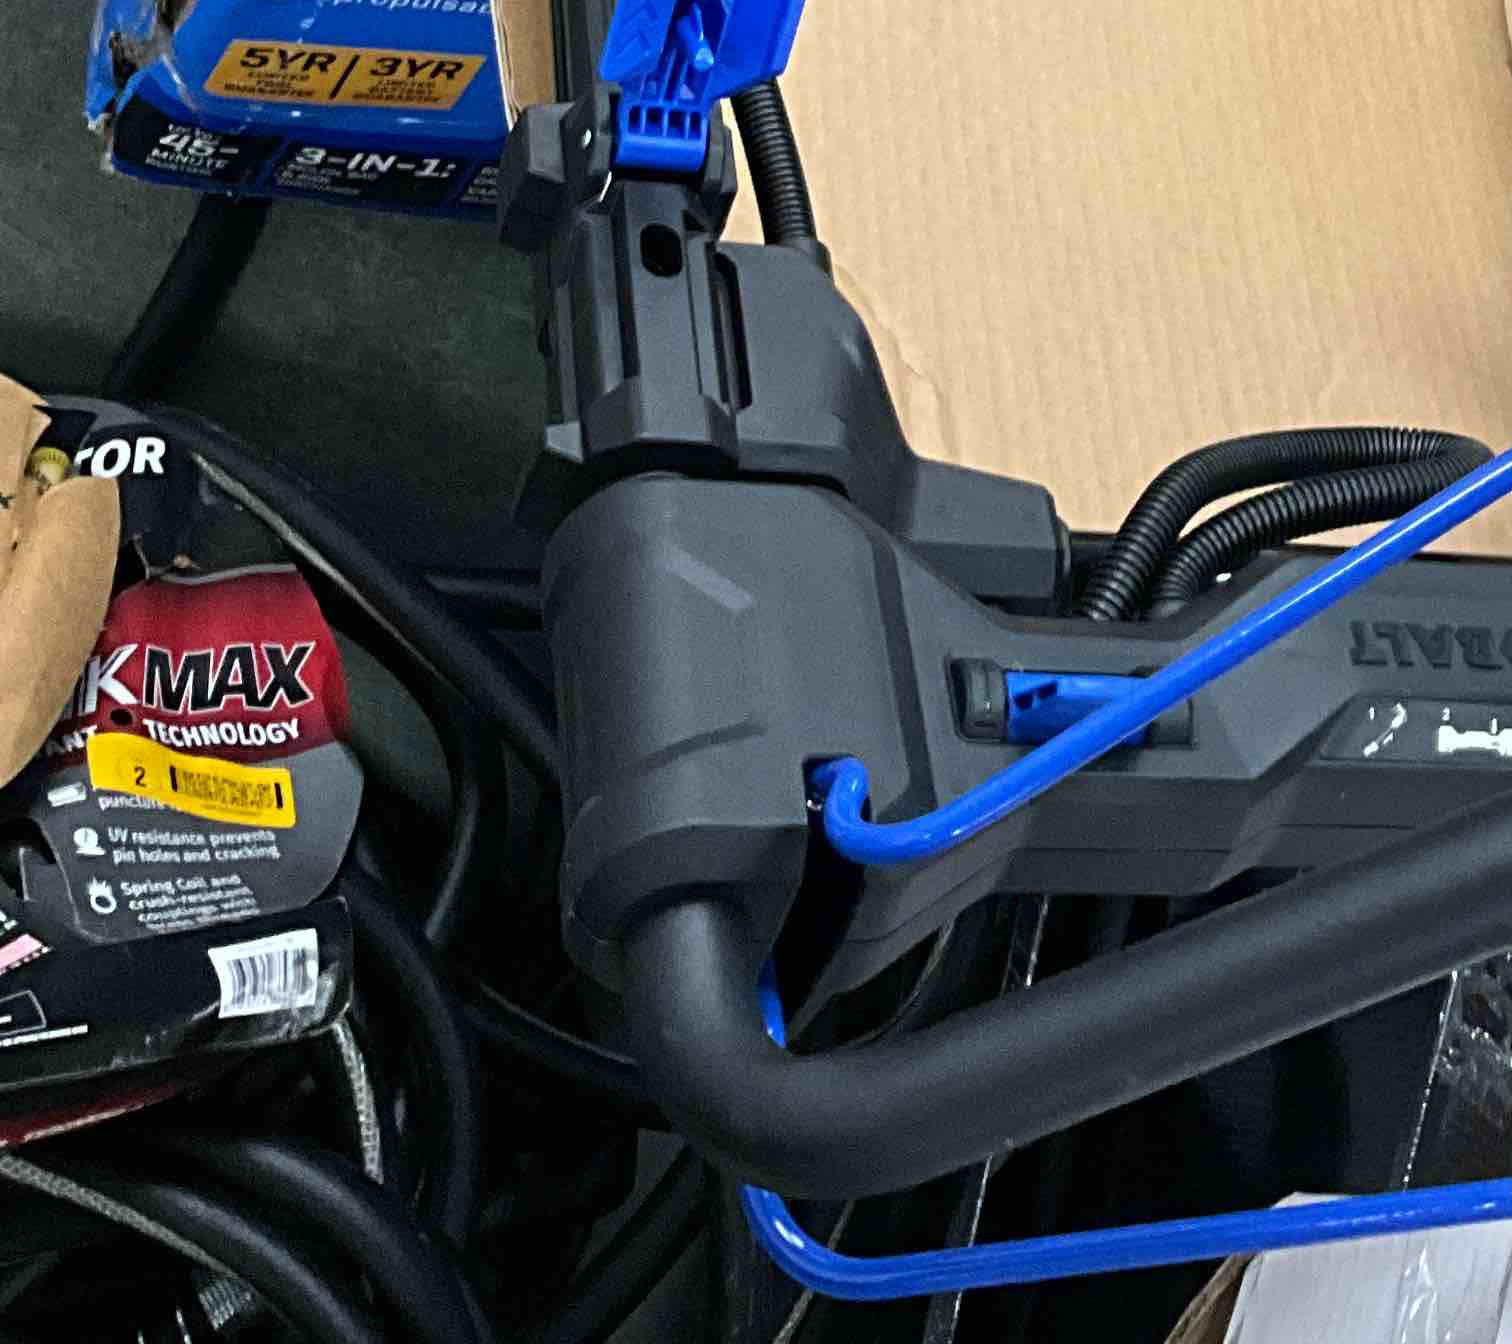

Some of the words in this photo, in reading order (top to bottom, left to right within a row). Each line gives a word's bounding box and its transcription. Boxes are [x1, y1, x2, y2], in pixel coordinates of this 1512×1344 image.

[240, 47, 337, 75] 5YR
[369, 57, 465, 81] 3YR
[142, 717, 300, 748] TECHNOLOGY
[133, 766, 146, 787] 2
[108, 826, 128, 843] UV
[132, 828, 206, 845] resistance
[210, 830, 276, 846] prevents
[112, 847, 136, 865] pin
[139, 847, 180, 862] holes
[183, 847, 210, 862] and
[120, 880, 175, 897] Spring
[211, 874, 241, 886] and
